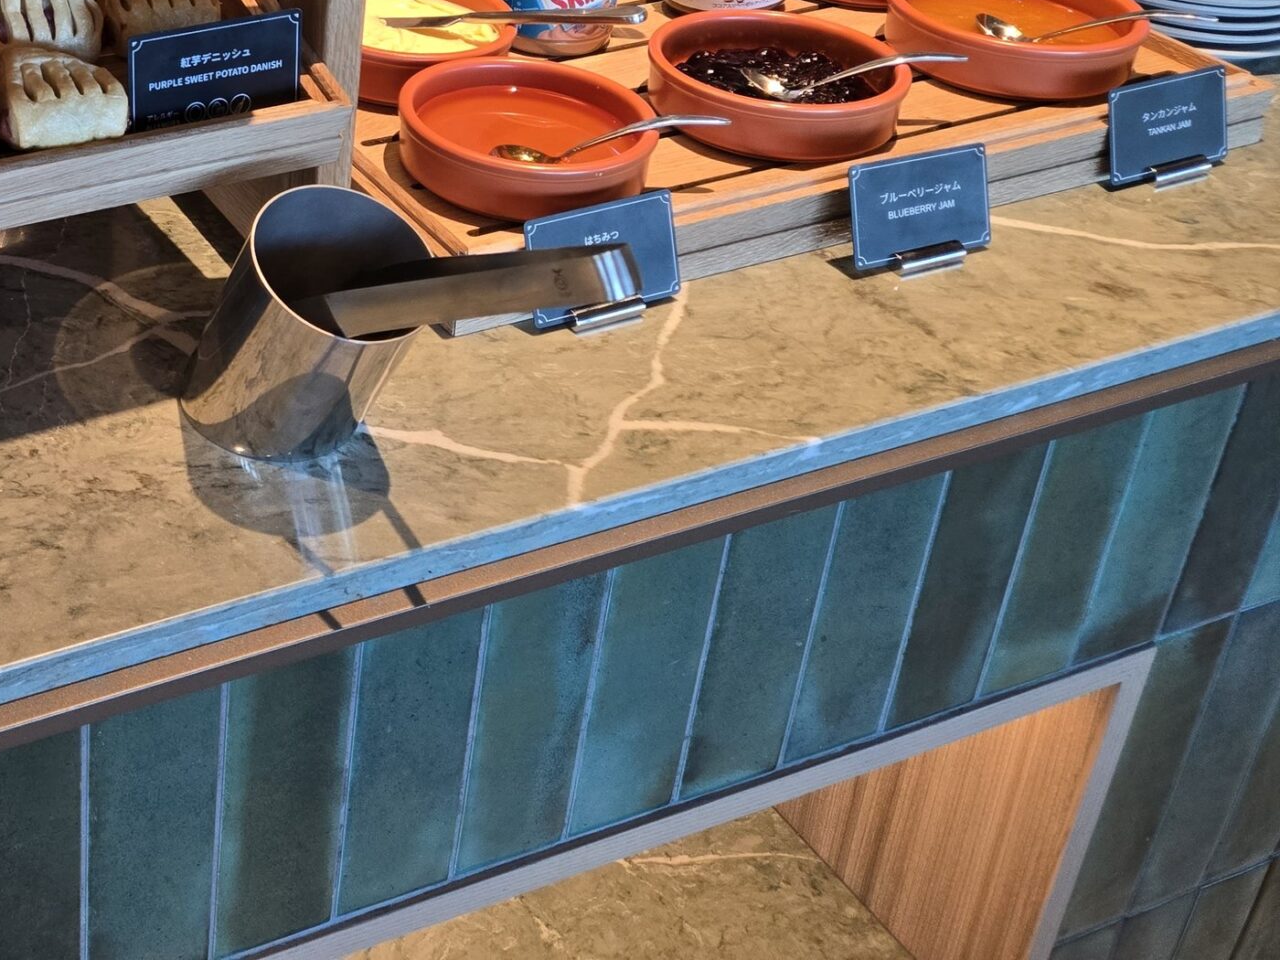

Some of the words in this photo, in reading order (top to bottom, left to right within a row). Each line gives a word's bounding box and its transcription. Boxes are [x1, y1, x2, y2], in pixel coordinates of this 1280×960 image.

[180, 48, 251, 69] 紅芋デニッシュ
[148, 77, 183, 91] PURPLE
[185, 72, 213, 86] SWEET
[215, 66, 249, 79] POTATO
[251, 59, 282, 73] DANISH
[1141, 102, 1197, 123] タンカンジャム
[1147, 123, 1176, 136] TANKAN
[1176, 119, 1192, 131] JAM
[880, 180, 961, 205] ブルーベリージャム
[888, 202, 937, 220] BLUEBERRY
[938, 199, 956, 210] JAM
[584, 230, 620, 246] はちみつ
